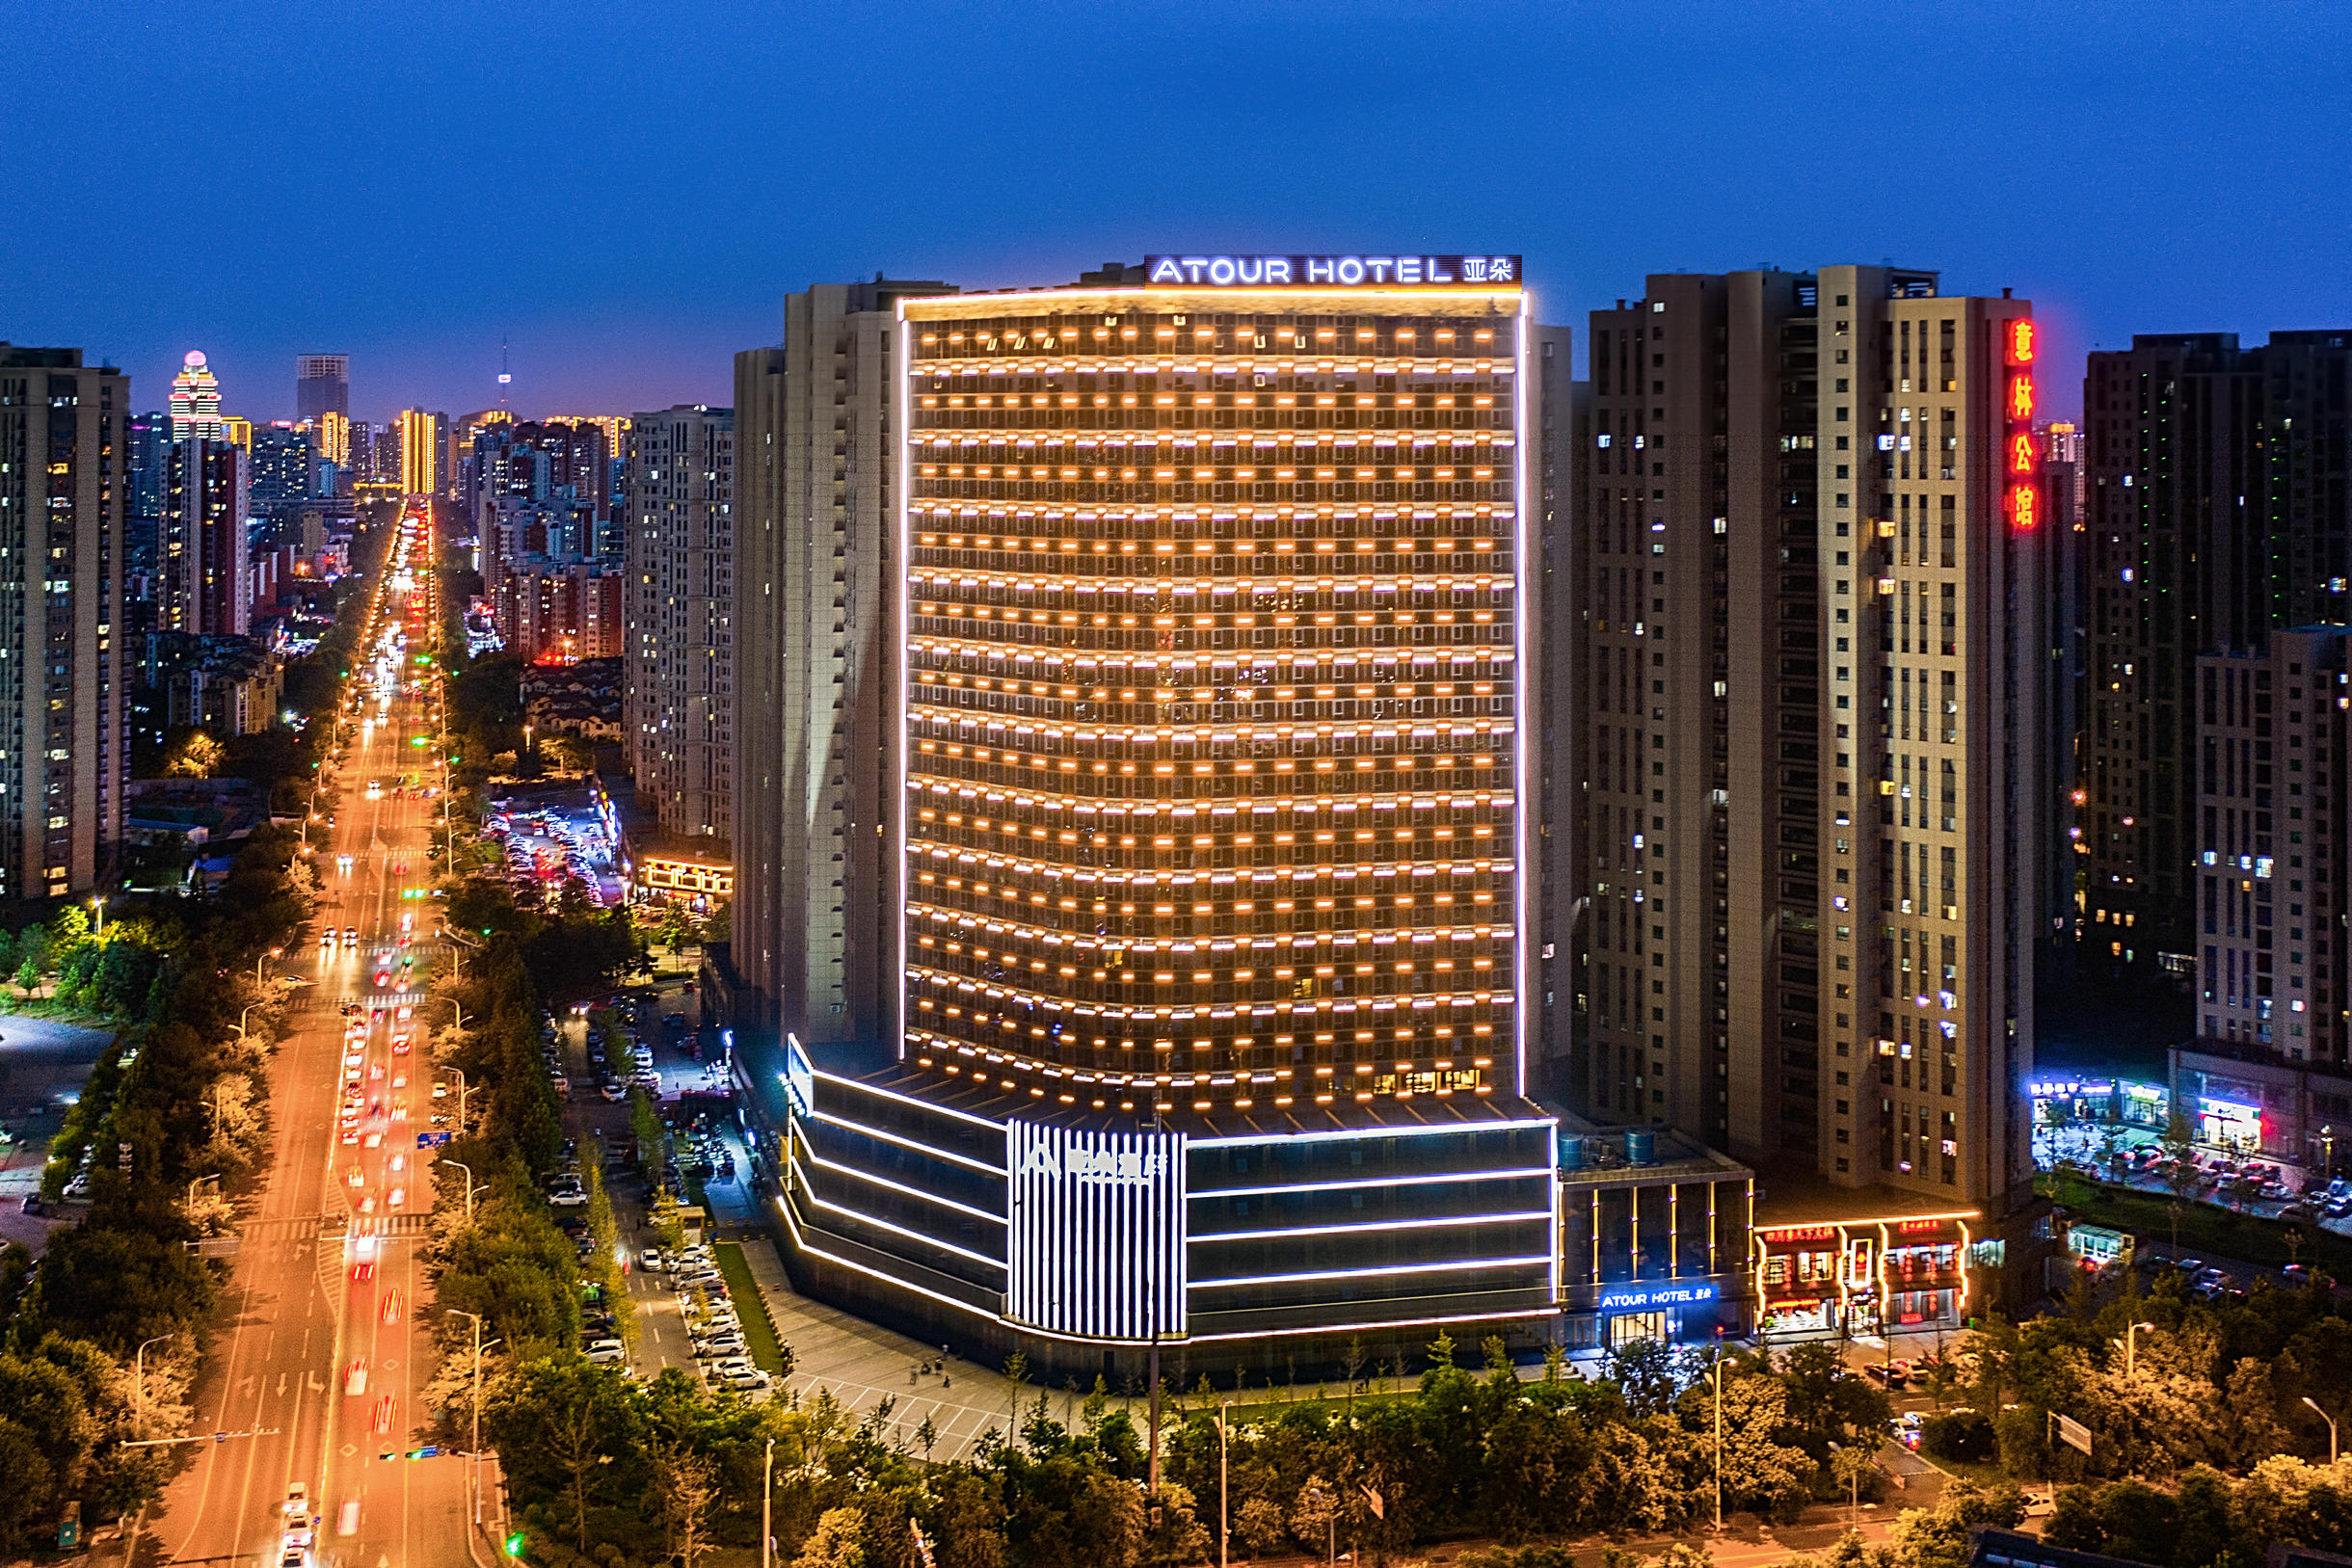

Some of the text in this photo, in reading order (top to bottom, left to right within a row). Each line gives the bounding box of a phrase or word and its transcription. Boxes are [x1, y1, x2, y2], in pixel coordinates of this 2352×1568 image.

[1153, 259, 1451, 283] ATOUR HOTEL
[1464, 258, 1512, 281] 亚朵
[1602, 1289, 1694, 1308] ATOUR HOTEL
